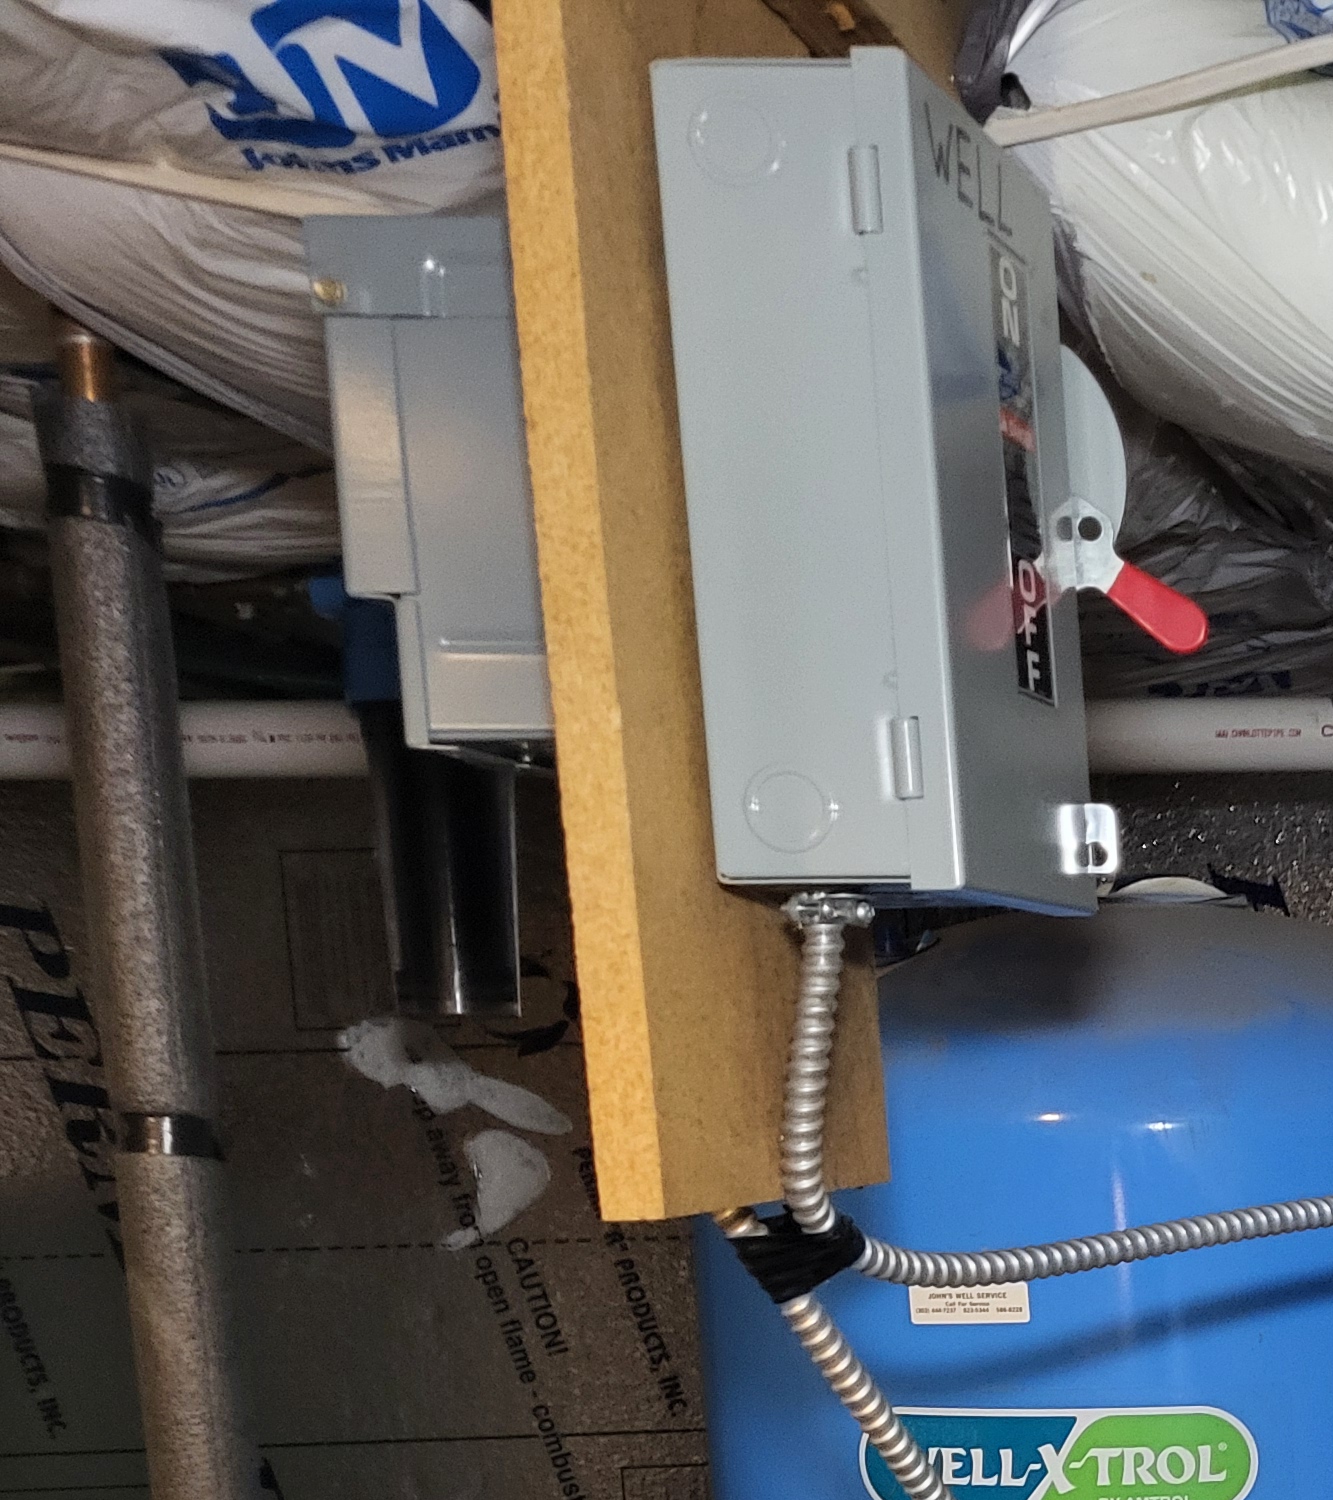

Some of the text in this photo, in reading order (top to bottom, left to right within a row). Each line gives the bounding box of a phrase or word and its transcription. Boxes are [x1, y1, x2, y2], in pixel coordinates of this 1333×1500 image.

[924, 101, 1013, 237] WELL
[999, 255, 1020, 347] ON
[1017, 558, 1041, 692] OFF
[426, 1126, 460, 1188] away
[475, 1255, 509, 1314] open
[502, 1319, 536, 1385] flame
[507, 1237, 569, 1358] CAUTION!
[928, 1292, 953, 1300] JOHN'S
[614, 1256, 671, 1373] PRODUCTS,
[659, 1374, 688, 1418] INC.
